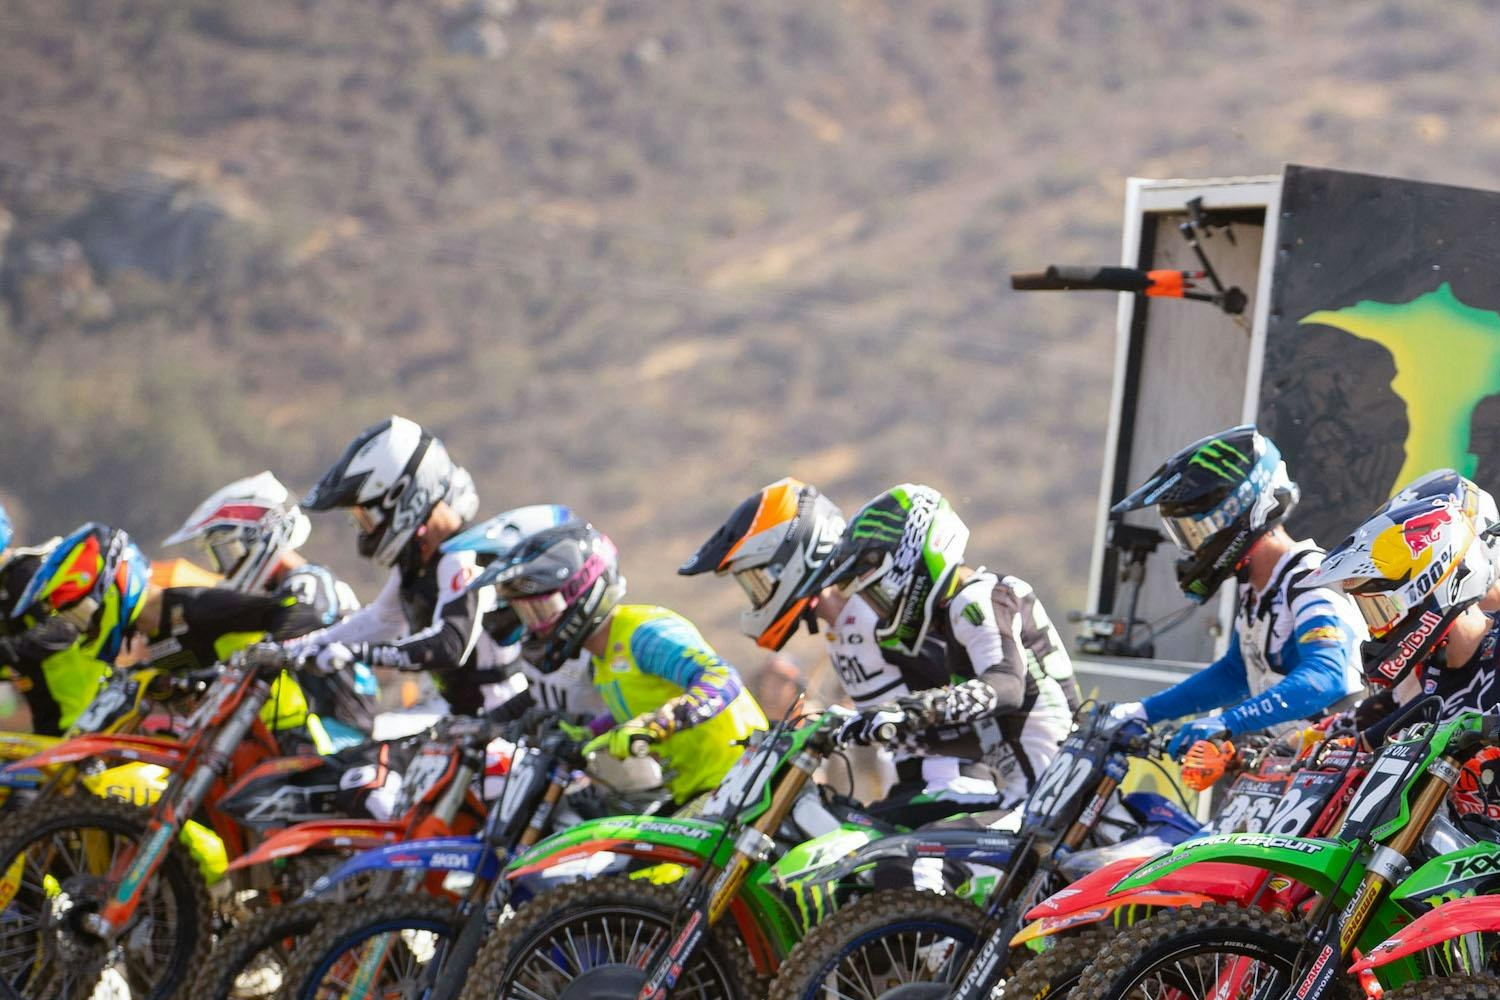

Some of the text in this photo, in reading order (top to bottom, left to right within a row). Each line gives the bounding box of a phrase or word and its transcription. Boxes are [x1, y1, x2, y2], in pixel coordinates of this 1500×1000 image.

[1342, 756, 1419, 824] 7
[1233, 836, 1324, 855] CIRCUIT
[1342, 887, 1378, 945] SHOWA
[1298, 946, 1333, 999] BRAKING
